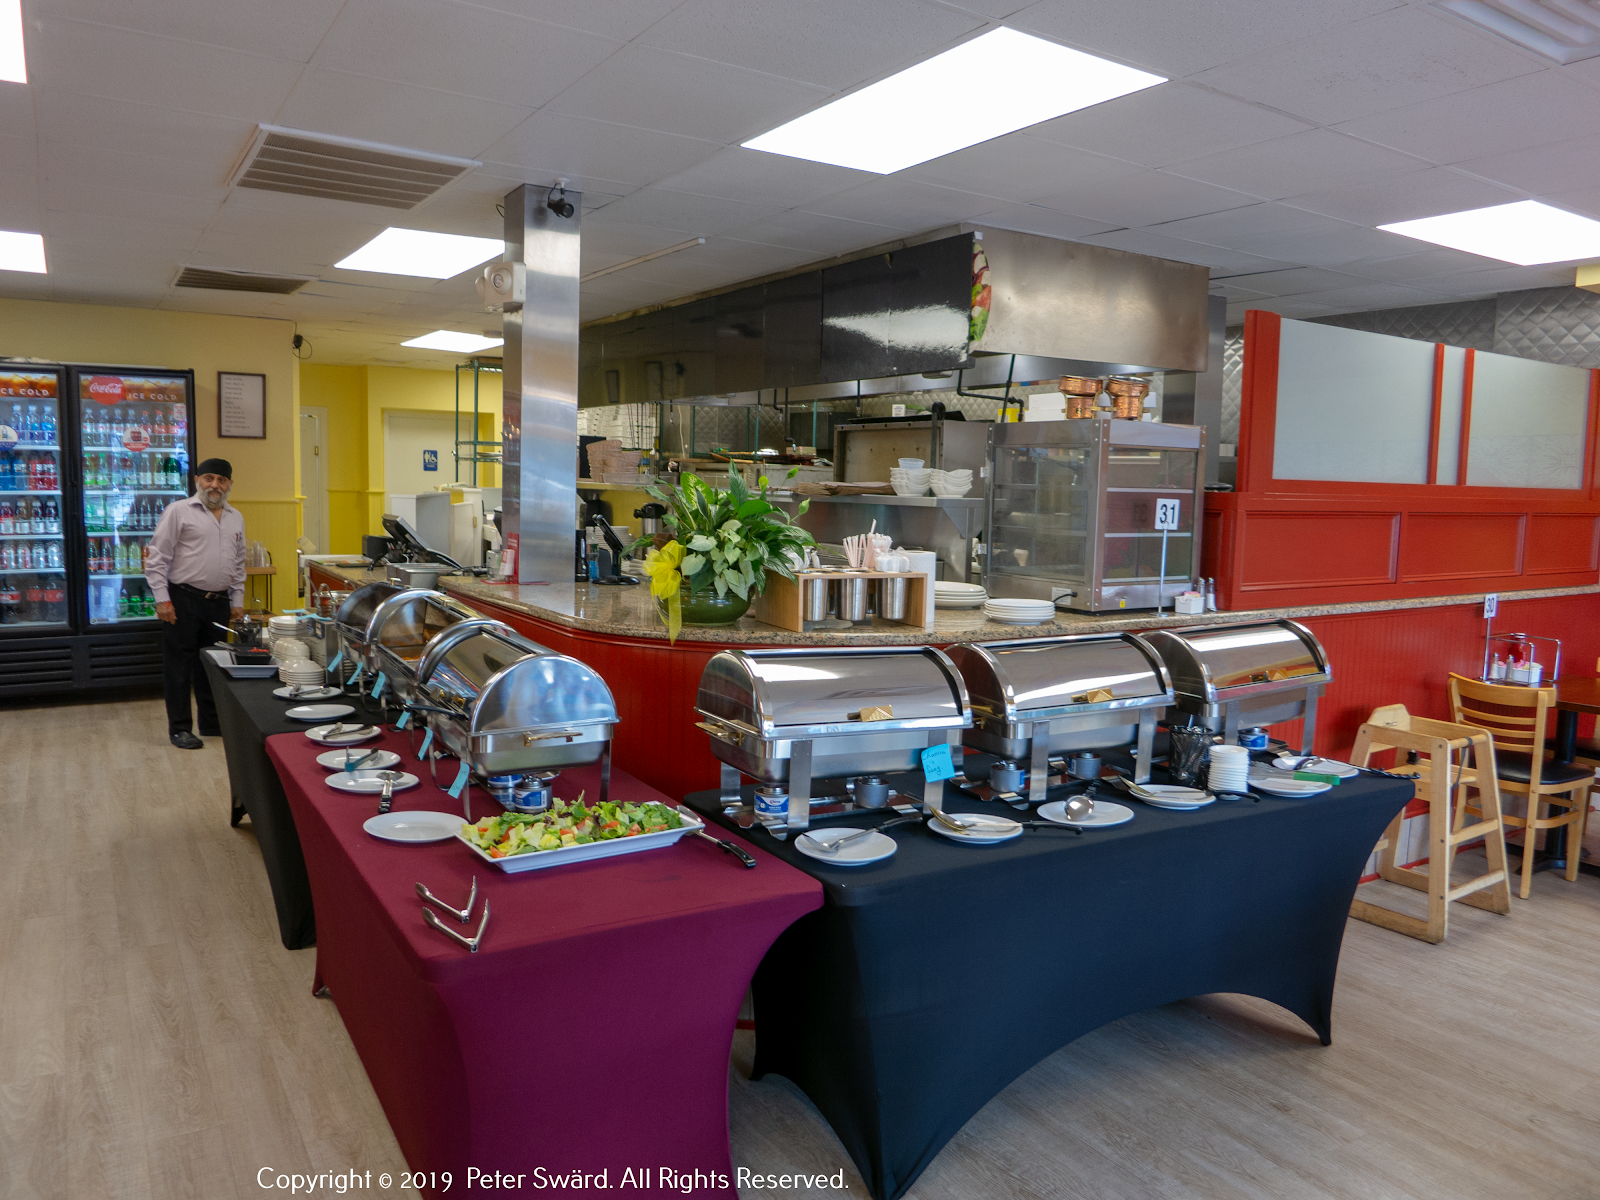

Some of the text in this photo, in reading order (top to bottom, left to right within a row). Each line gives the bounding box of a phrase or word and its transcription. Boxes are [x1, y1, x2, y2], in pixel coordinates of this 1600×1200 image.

[0, 388, 15, 396] CE
[128, 392, 177, 401] ICE COLD
[1159, 503, 1176, 524] 31
[1486, 597, 1495, 613] 30
